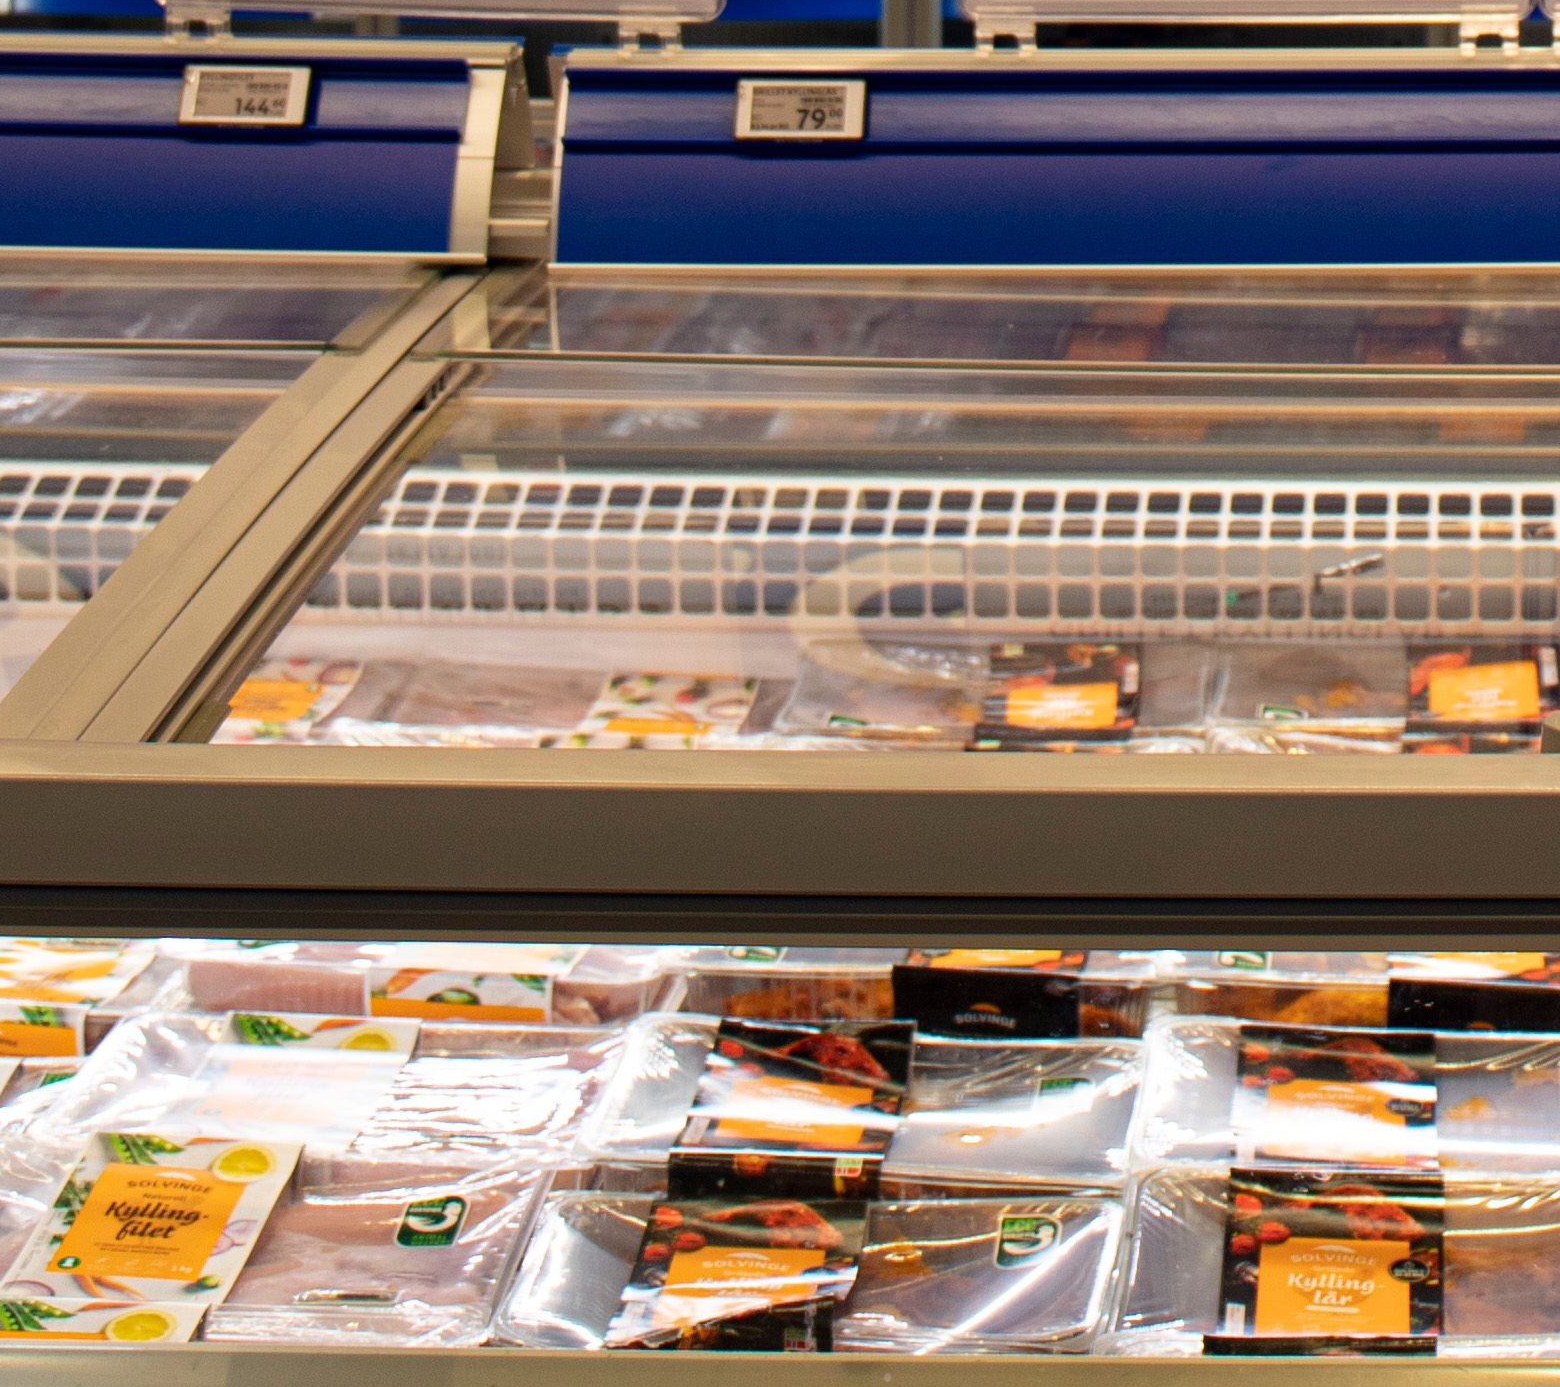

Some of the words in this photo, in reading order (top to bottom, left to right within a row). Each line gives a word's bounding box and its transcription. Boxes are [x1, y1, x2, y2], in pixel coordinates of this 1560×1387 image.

[127, 1180, 215, 1195] SOLVINGE
[105, 1200, 209, 1228] Kylling-
[116, 1221, 178, 1242] filet
[702, 1258, 792, 1273] SOLVINGE
[1290, 1252, 1378, 1266] SOLVINGE
[1287, 1272, 1385, 1297] Kylling-
